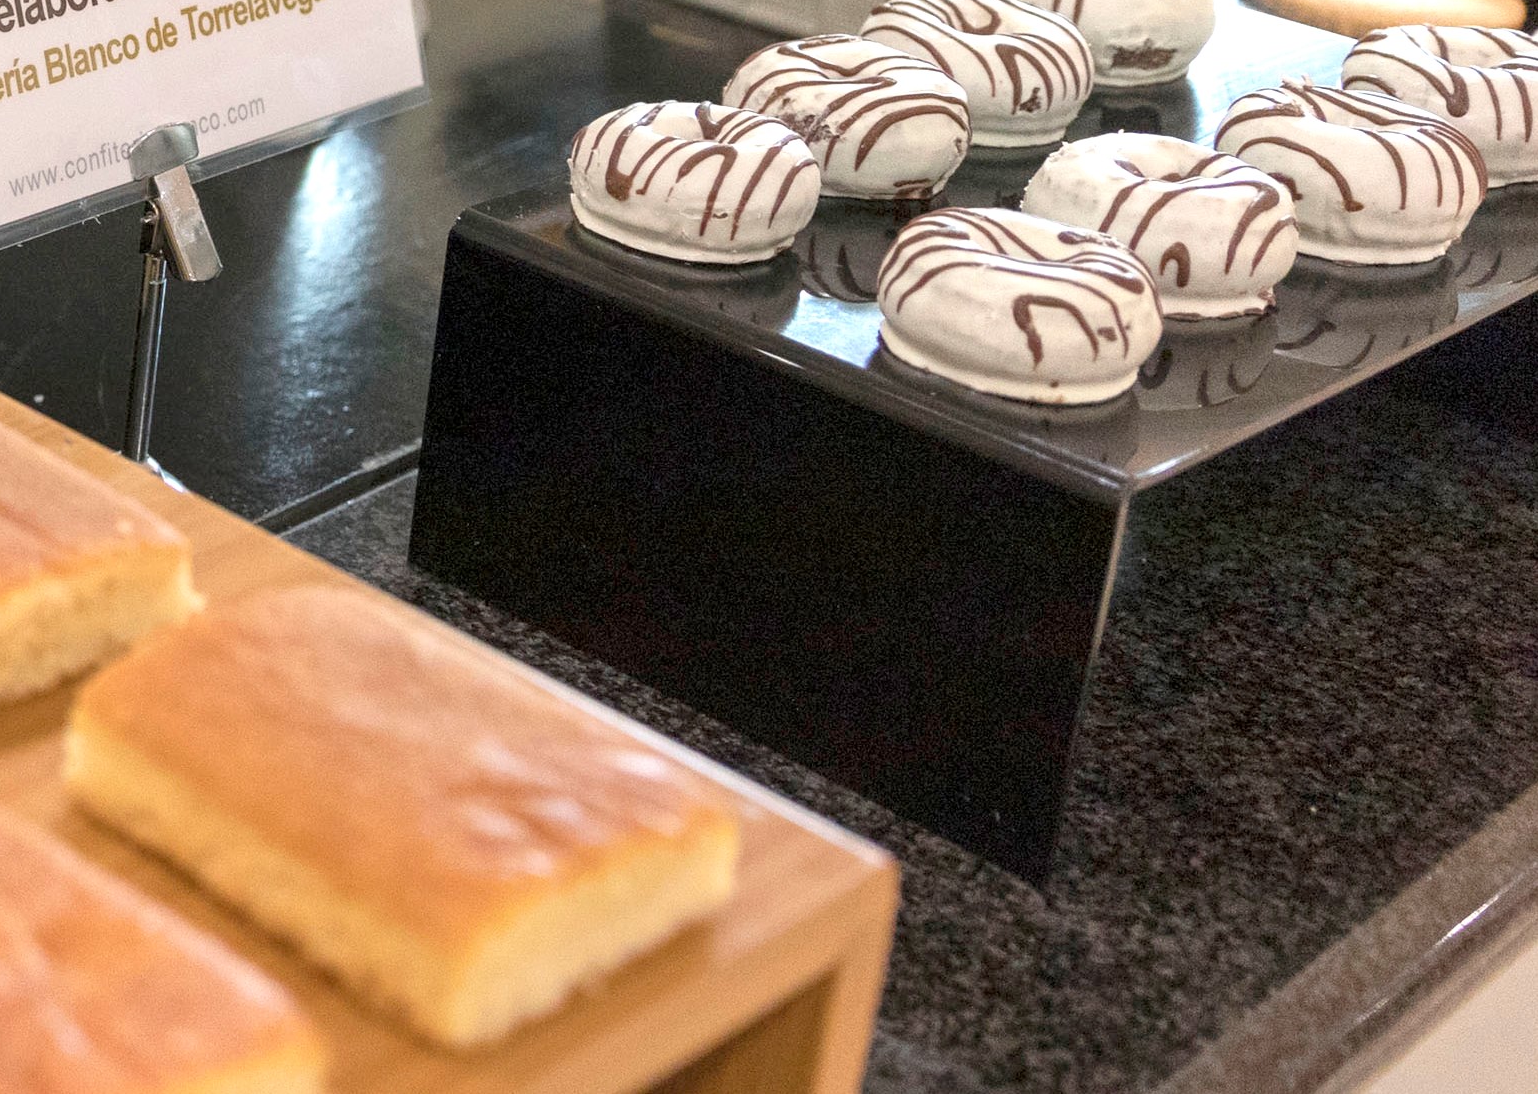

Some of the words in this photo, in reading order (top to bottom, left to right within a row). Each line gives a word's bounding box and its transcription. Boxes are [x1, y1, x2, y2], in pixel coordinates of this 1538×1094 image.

[43, 34, 141, 85] Blanco
[146, 16, 179, 53] de
[8, 97, 266, 198] www.confitenco.com
